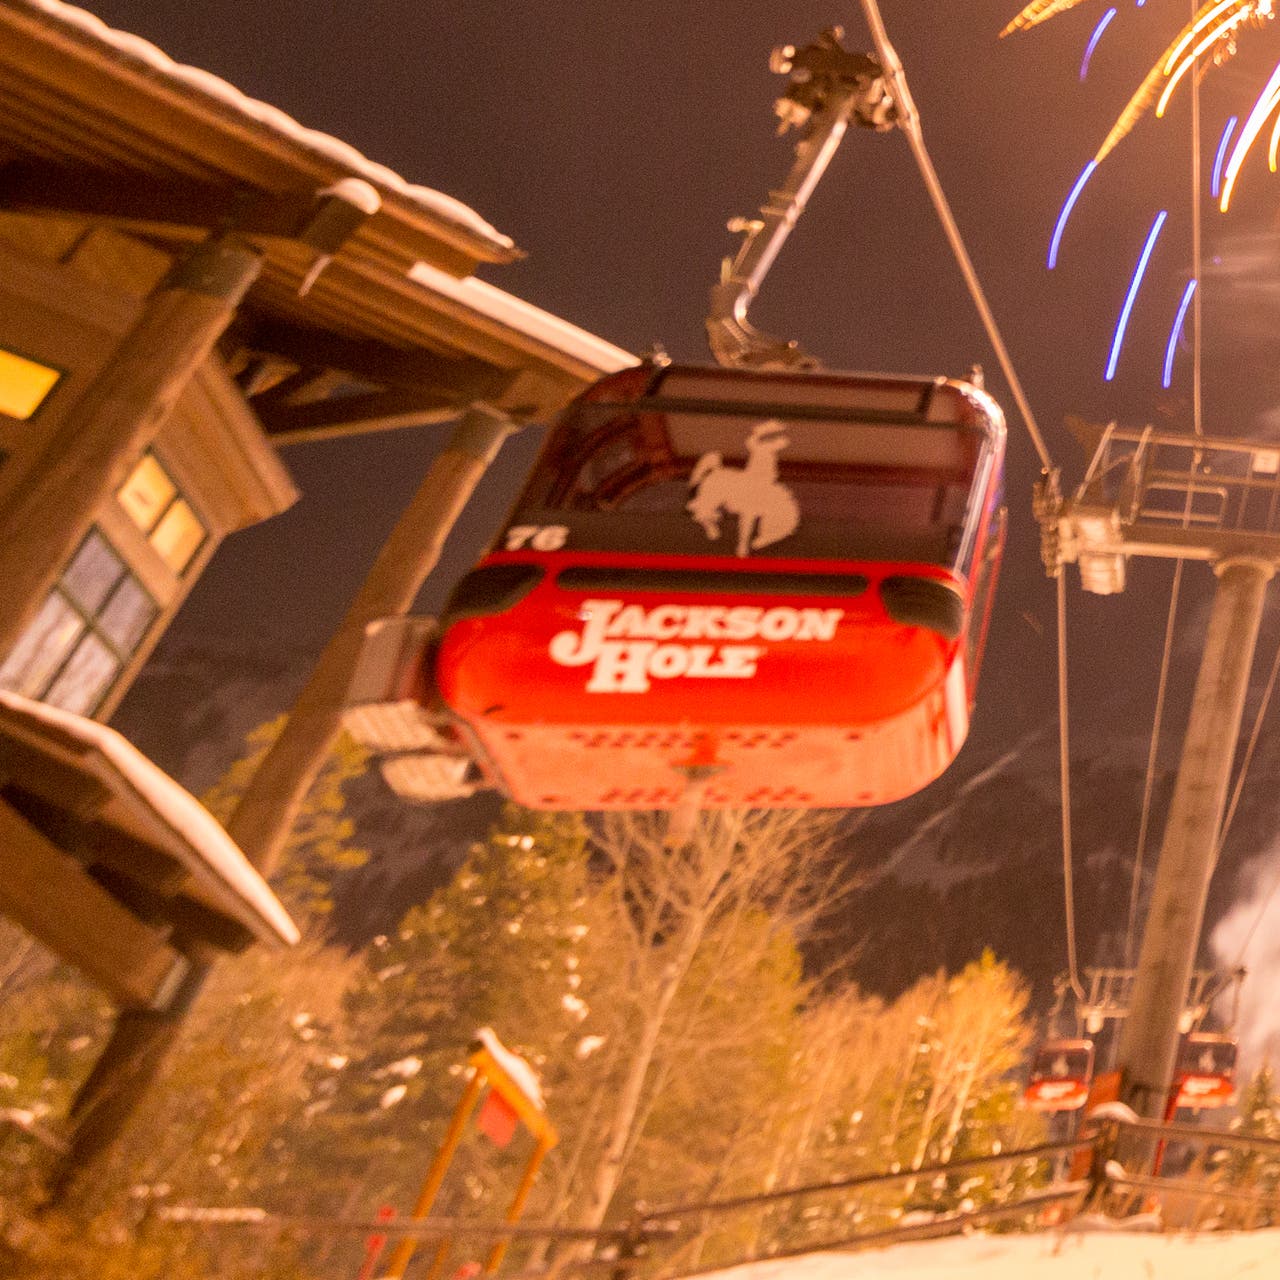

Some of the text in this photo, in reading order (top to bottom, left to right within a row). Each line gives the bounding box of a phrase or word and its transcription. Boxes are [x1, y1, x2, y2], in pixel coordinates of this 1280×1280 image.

[505, 524, 569, 551] 76
[549, 599, 844, 667] JACKSON
[585, 640, 760, 693] HOLE
